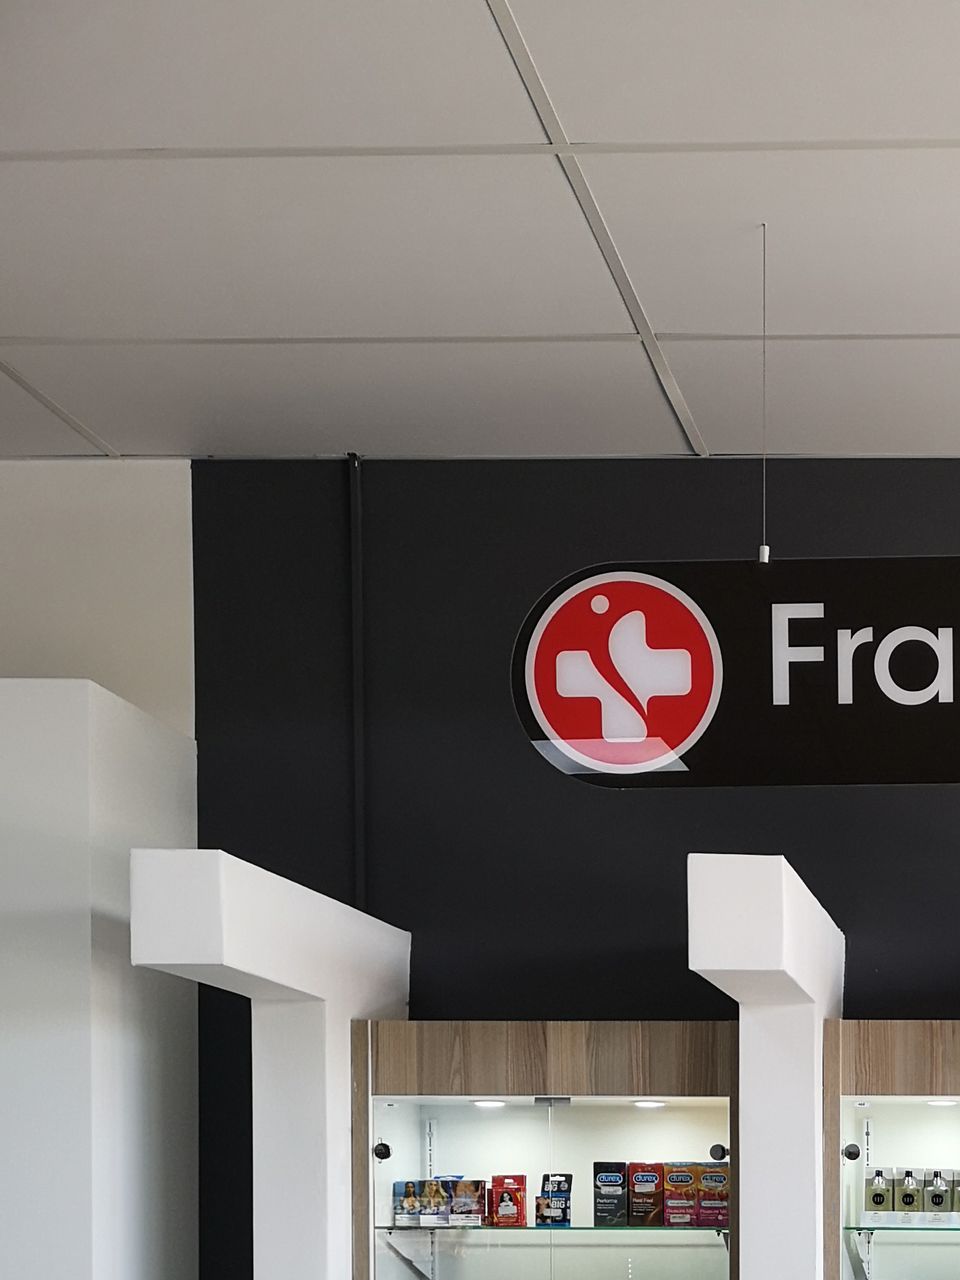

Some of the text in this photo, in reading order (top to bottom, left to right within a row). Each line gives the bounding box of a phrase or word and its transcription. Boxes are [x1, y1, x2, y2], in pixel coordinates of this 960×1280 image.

[599, 1174, 620, 1183] durex
[635, 1173, 656, 1183] durex
[669, 1174, 691, 1183] durex
[551, 1200, 565, 1208] BIG
